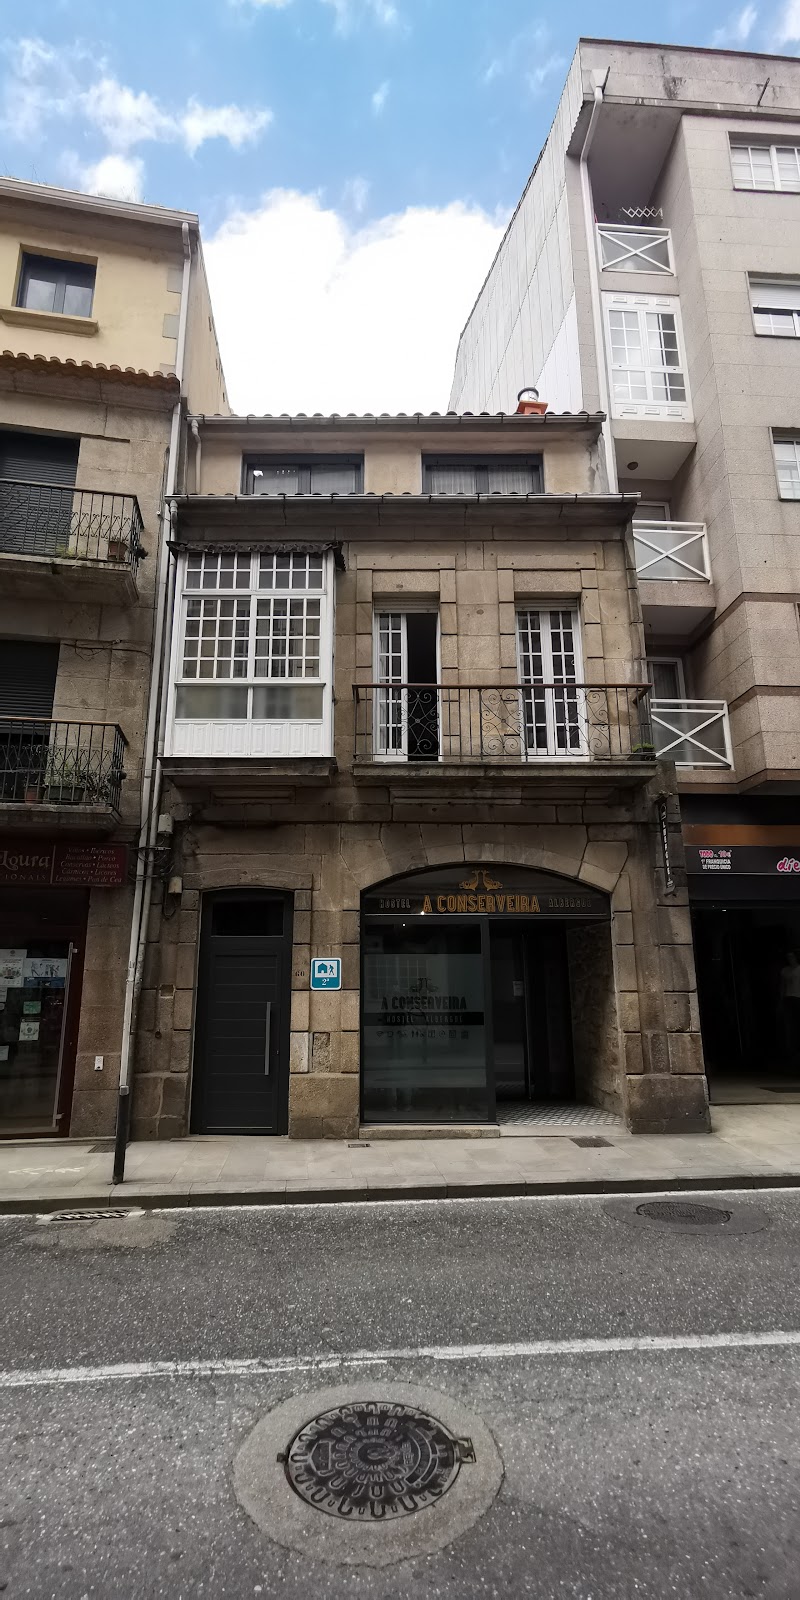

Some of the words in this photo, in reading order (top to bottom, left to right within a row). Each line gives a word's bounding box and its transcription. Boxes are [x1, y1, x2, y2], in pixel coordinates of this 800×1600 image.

[379, 898, 411, 909] HOSTEL
[423, 895, 433, 912] A
[437, 895, 541, 913] CONSERVEIRA
[381, 996, 388, 1010] A
[391, 996, 467, 1010] CONSERVEIRA
[386, 1015, 414, 1024] HOSTEL
